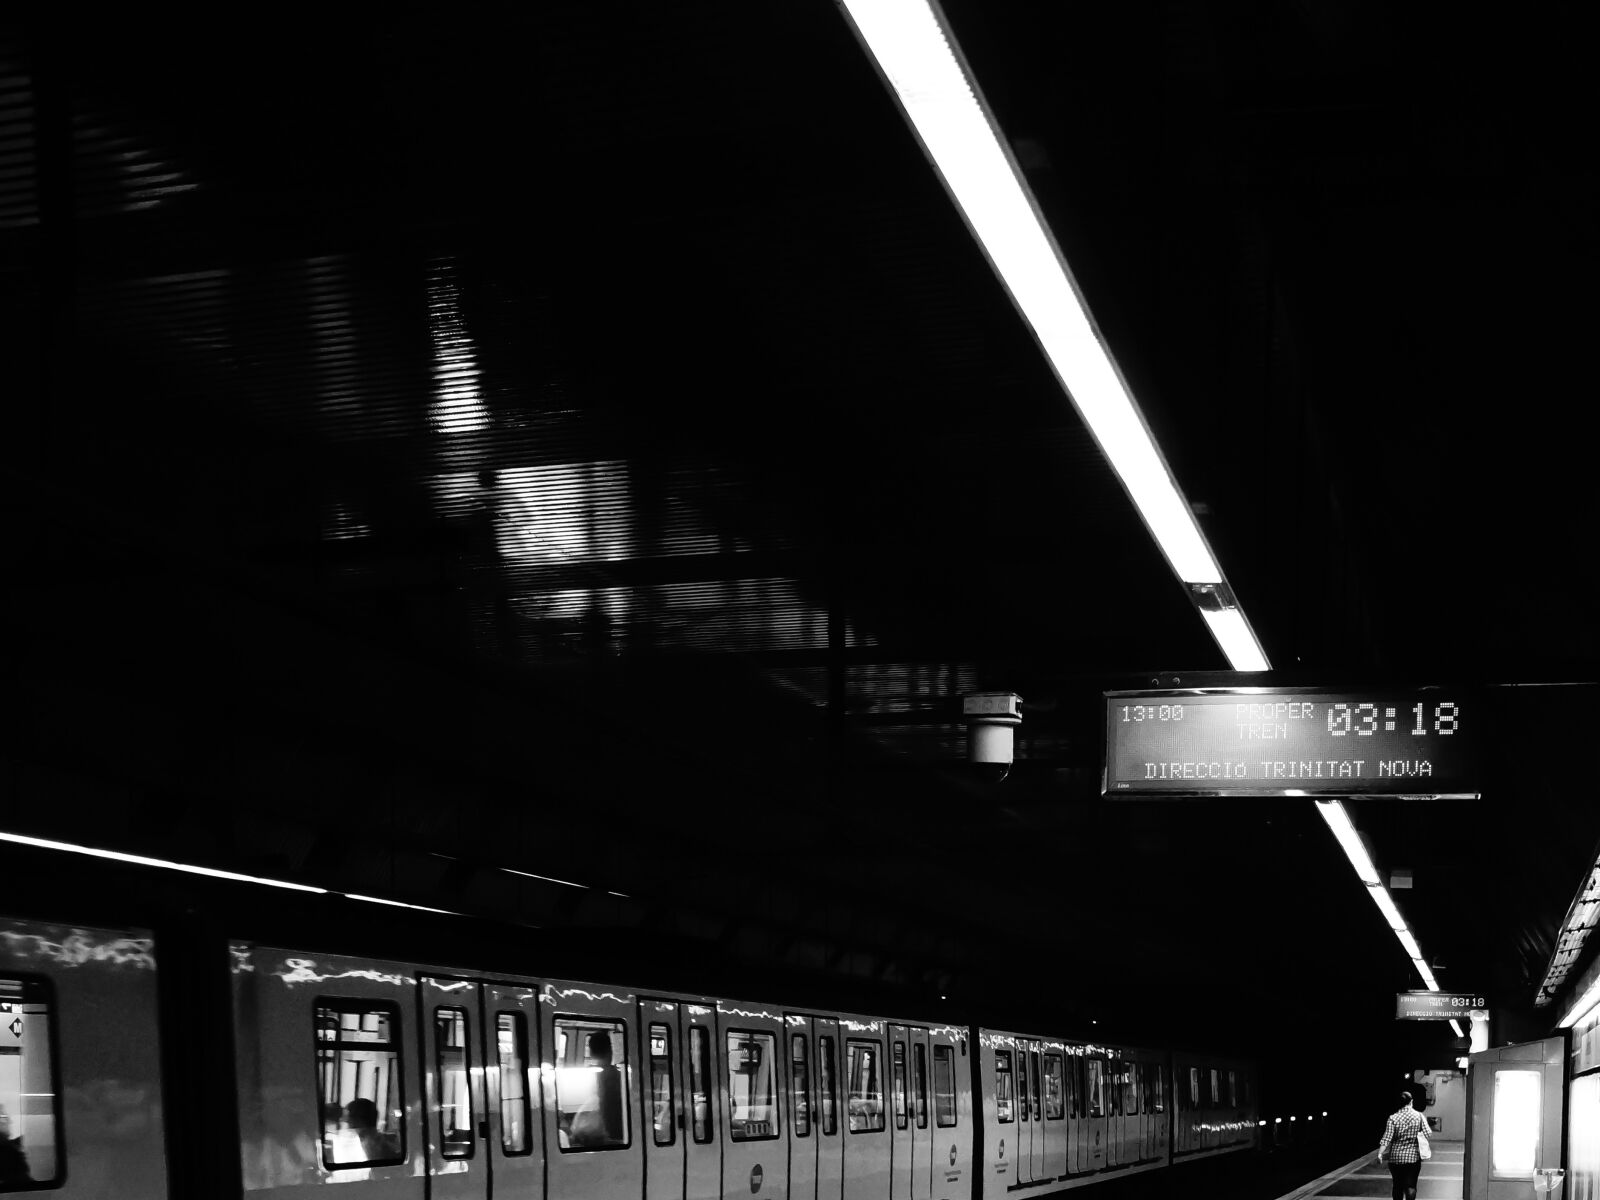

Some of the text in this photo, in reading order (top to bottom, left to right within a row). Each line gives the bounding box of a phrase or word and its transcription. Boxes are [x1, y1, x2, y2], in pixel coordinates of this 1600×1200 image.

[1122, 705, 1184, 722] 13:00
[1235, 702, 1314, 721] PROPER
[1327, 702, 1459, 736] 03:18
[1235, 722, 1287, 740] TREN
[1261, 760, 1365, 778] TRINITAT
[1379, 760, 1432, 777] NOVA
